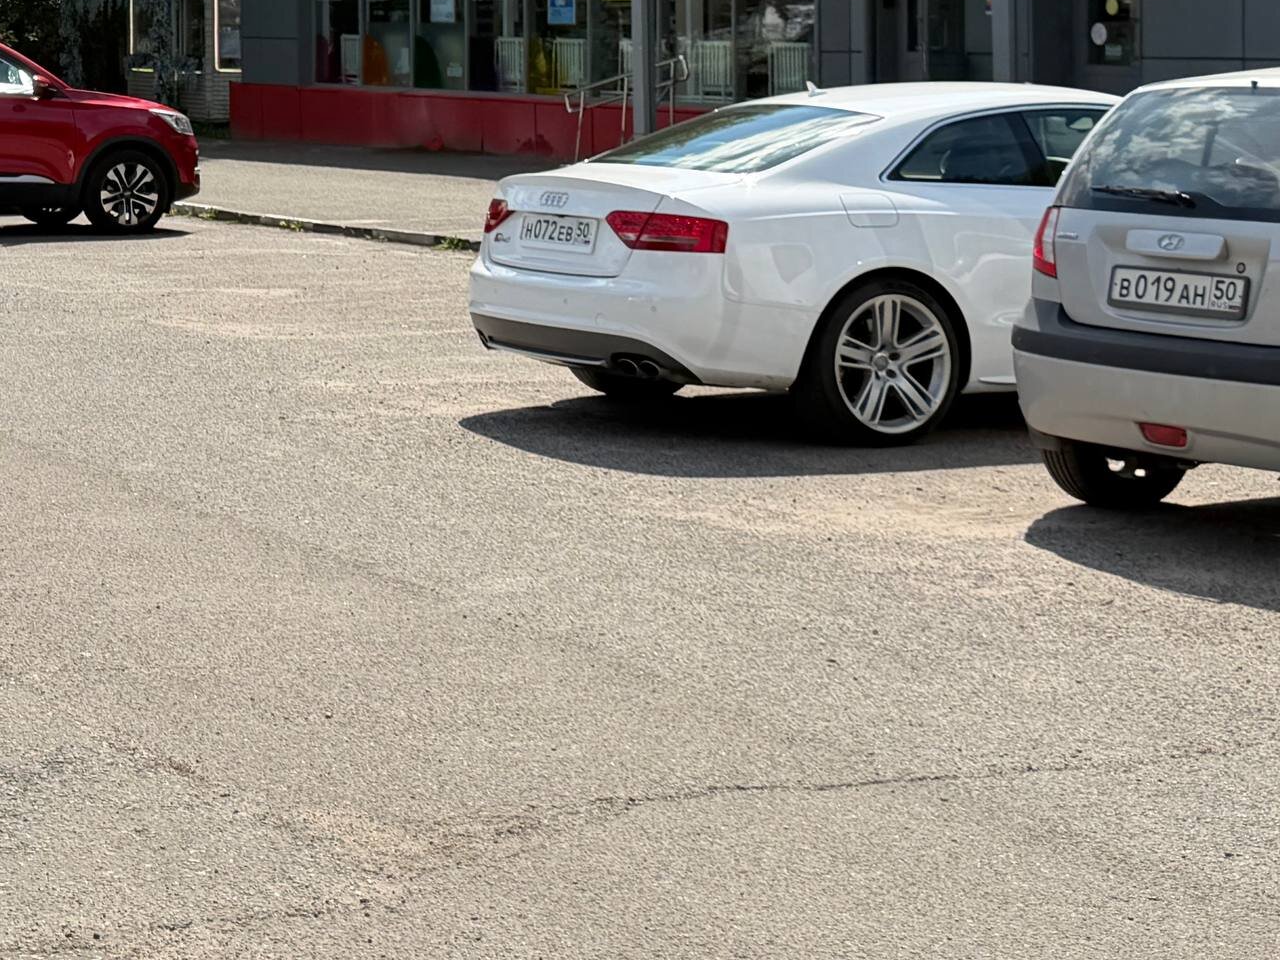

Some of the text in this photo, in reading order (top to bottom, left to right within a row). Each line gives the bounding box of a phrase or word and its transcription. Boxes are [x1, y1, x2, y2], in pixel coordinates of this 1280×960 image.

[576, 222, 590, 239] 50
[1118, 274, 1237, 306] В019АН 50
